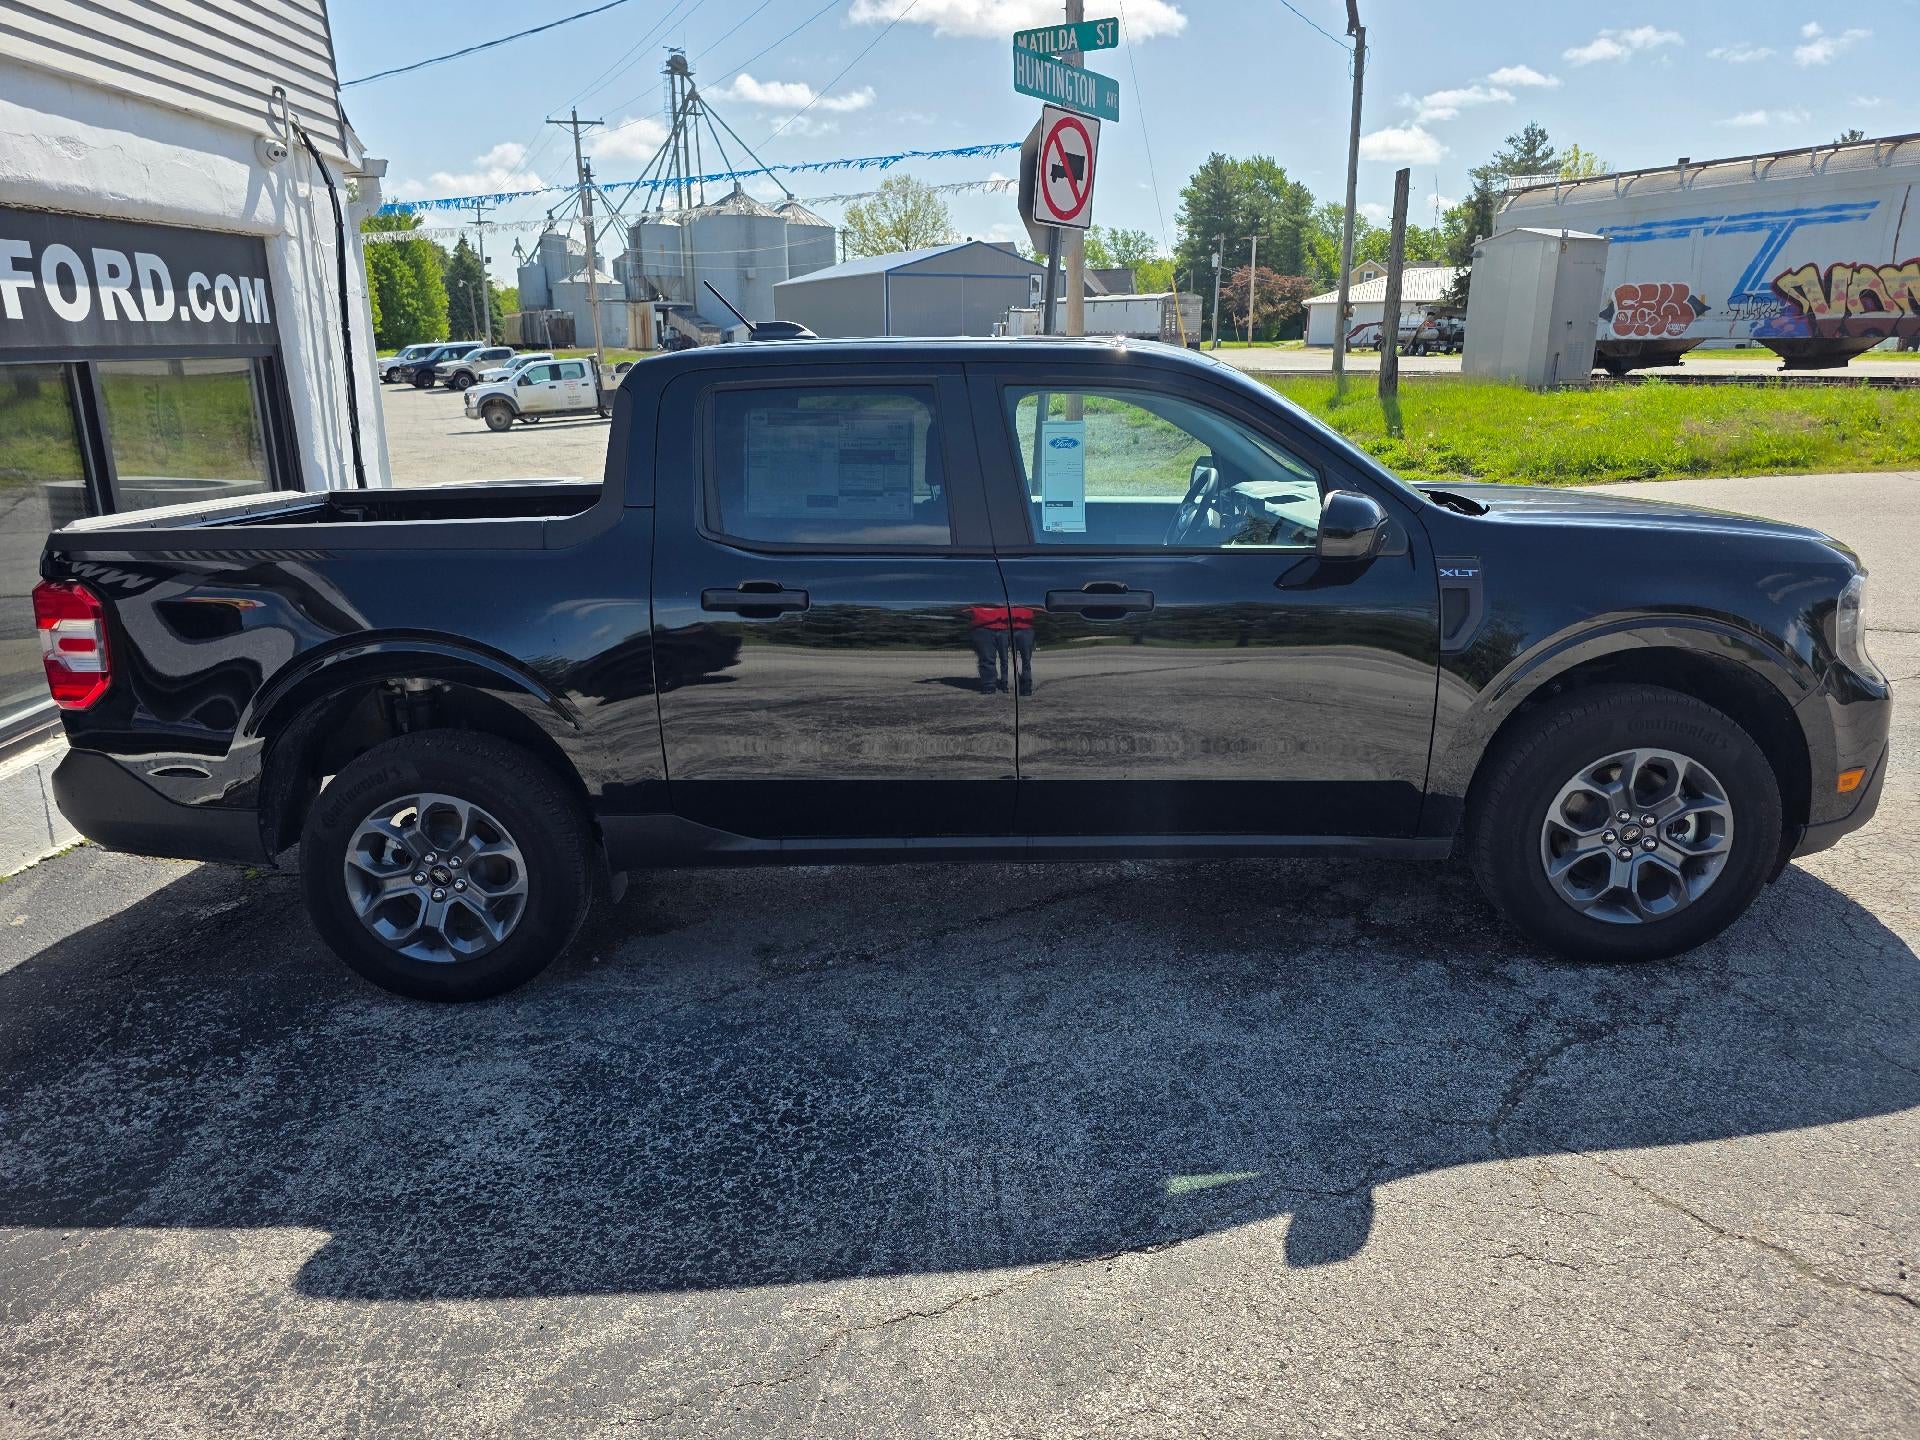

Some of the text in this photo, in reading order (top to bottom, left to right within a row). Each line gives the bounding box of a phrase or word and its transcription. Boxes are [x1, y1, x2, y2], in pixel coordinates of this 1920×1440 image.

[1017, 22, 1114, 54] MATILDA ST
[1016, 52, 1118, 109] HUNTINGTON AVE
[0, 238, 270, 323] FORD.COM
[1440, 568, 1479, 577] XLT
